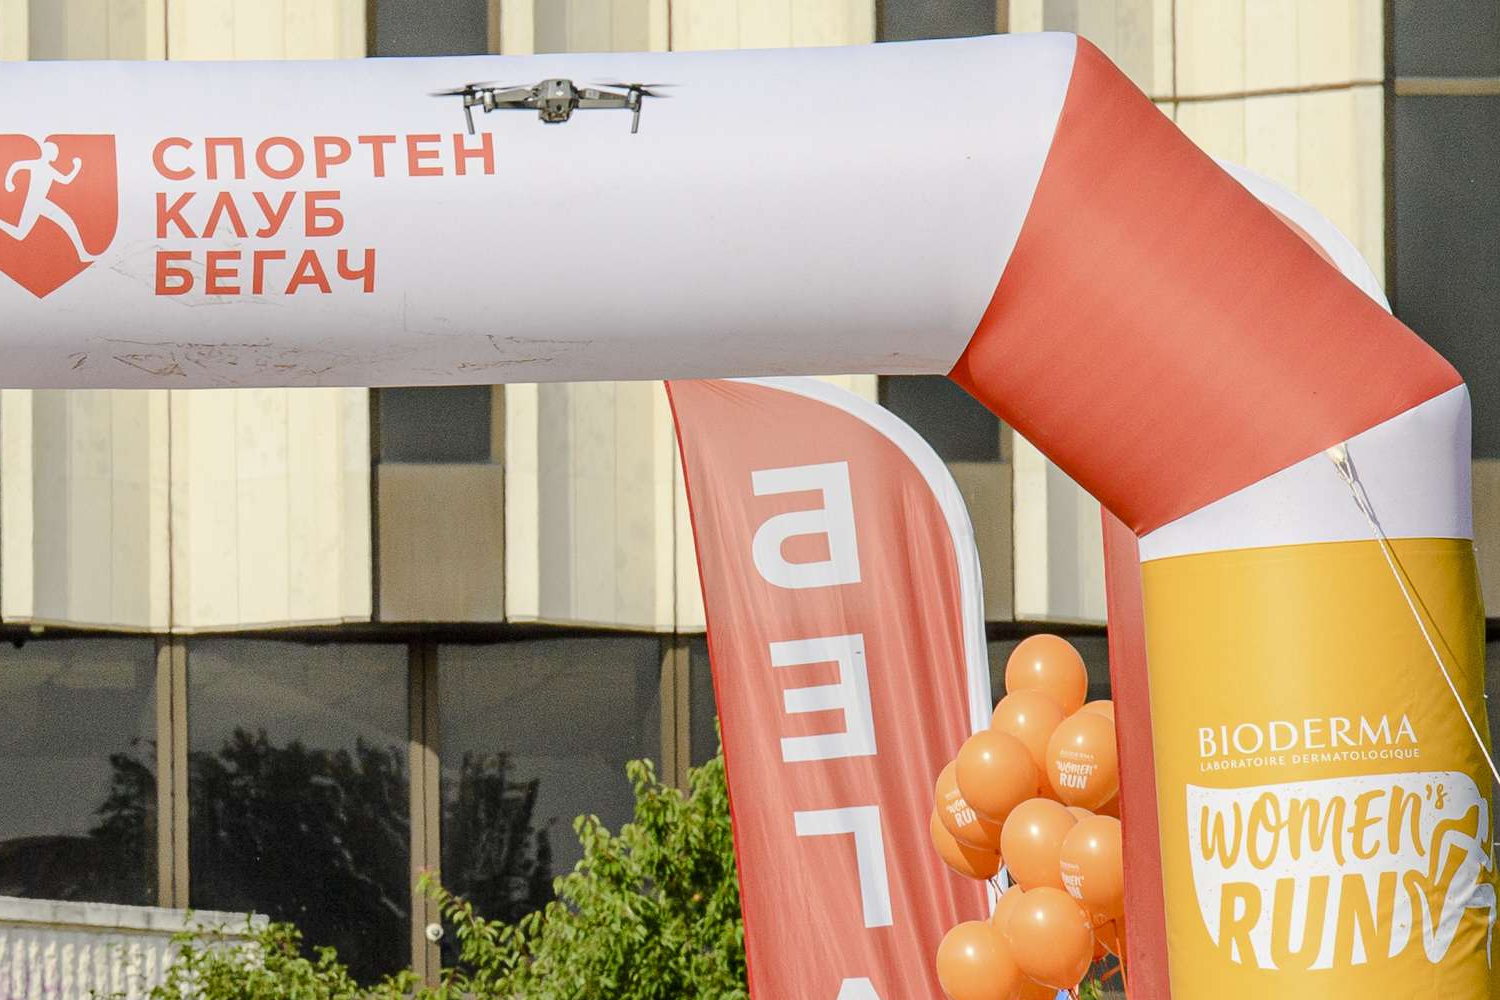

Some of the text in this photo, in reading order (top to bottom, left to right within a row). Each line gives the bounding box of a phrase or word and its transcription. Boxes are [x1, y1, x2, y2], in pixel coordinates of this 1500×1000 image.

[151, 132, 496, 181] СПОРТЕН
[157, 190, 345, 240] КЛУБ
[156, 248, 376, 297] БЕГАЧ
[1199, 714, 1419, 757] BIODERMA
[1201, 748, 1420, 772] LABORATOIRE DERMATOLOGIQUE
[1059, 773, 1087, 789] RUN
[1218, 871, 1398, 970] RUN
